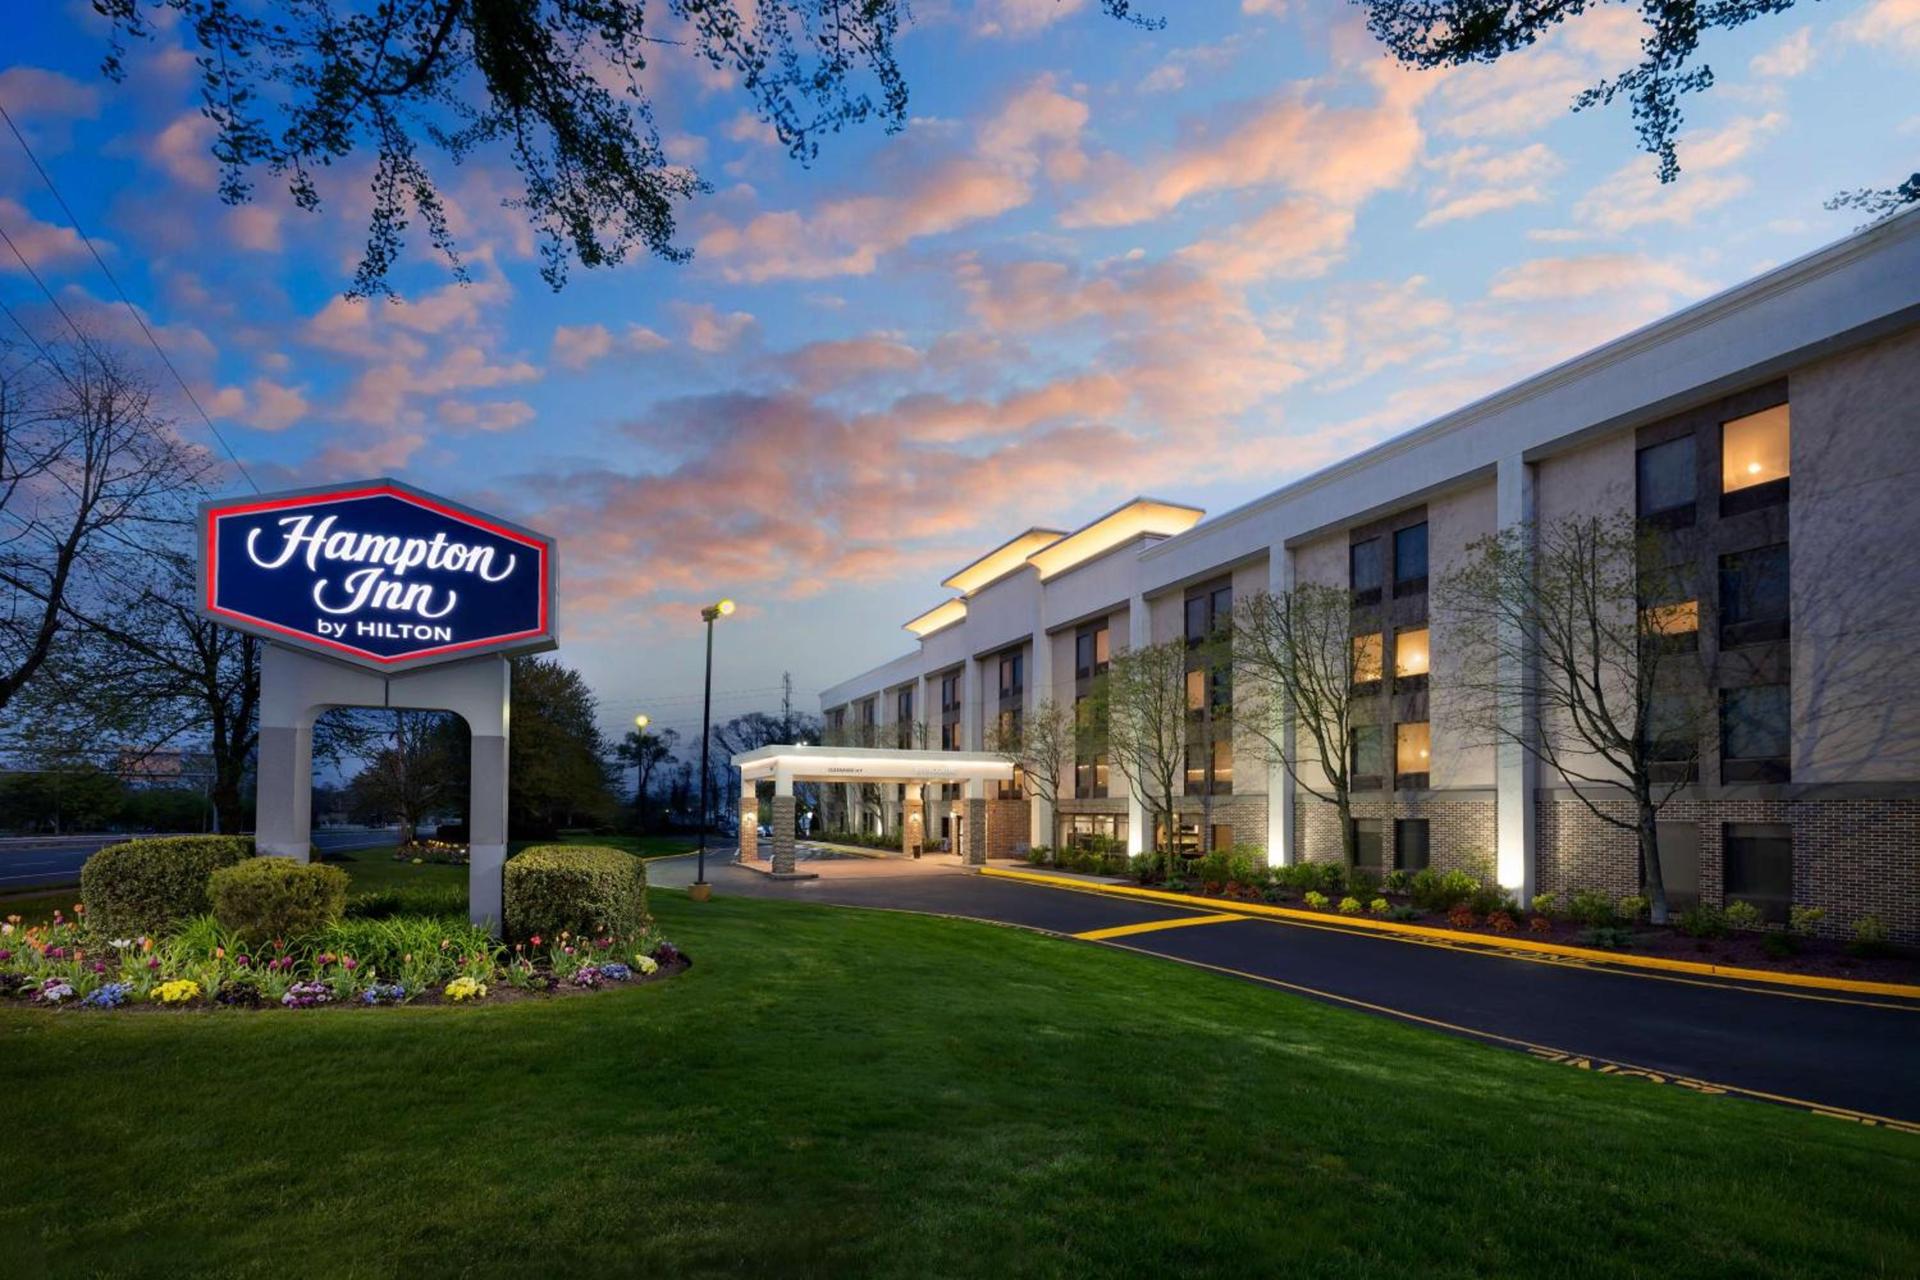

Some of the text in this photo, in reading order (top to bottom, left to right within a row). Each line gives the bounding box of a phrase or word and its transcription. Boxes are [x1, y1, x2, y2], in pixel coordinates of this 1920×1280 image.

[247, 515, 516, 581] Hampton
[313, 568, 457, 618] Inn
[317, 618, 452, 642] by HILTON
